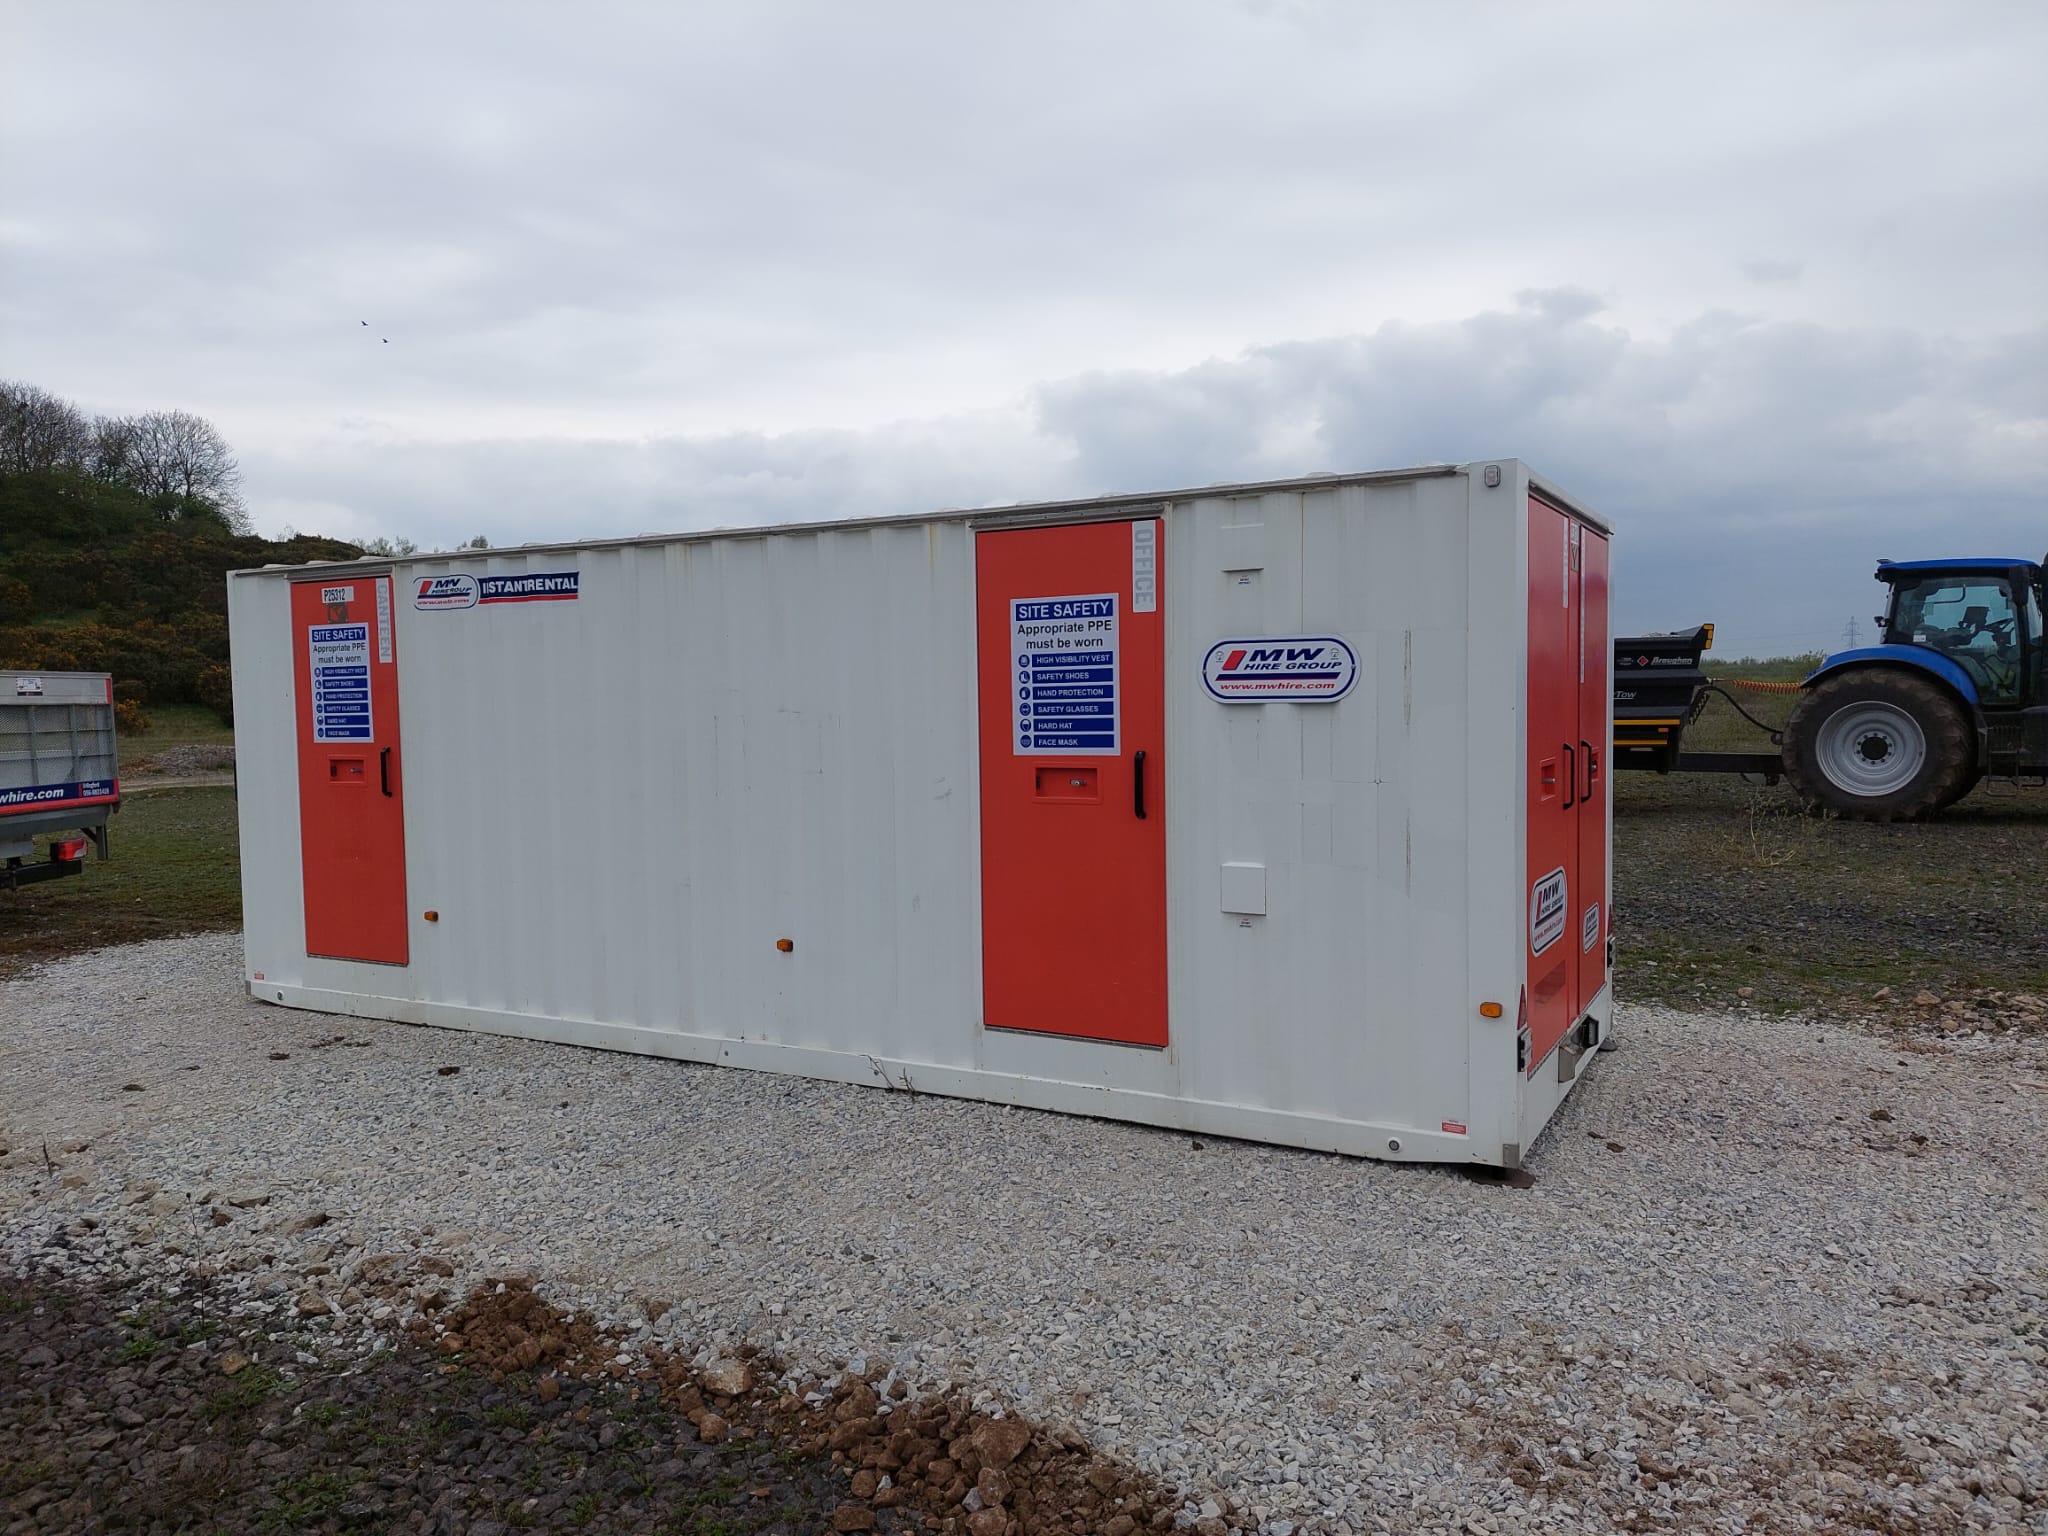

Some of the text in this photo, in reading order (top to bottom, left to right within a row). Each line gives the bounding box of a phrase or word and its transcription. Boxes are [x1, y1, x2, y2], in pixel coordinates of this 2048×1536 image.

[1135, 528, 1154, 604] OFFICE
[323, 588, 346, 602] P25312
[1018, 601, 1109, 619] SITE SAFETY
[378, 584, 391, 657] CANTEEN
[1017, 620, 1113, 637] Appropriate PPE
[313, 628, 364, 641] SITE SAFETY
[313, 642, 367, 653] Appropriate PPE
[1026, 637, 1103, 649] must be worn
[318, 655, 362, 664] must be worn
[1036, 654, 1110, 664] HIGH VISIBILITY VEST
[1249, 648, 1325, 662] MW
[1243, 661, 1343, 671] HIRE GROUP
[1220, 682, 1336, 690] www.mwhire.com
[1037, 688, 1104, 697] HAND PROTECTION
[1614, 690, 1637, 698] Tow
[1065, 705, 1099, 713] GLASSES
[1058, 738, 1079, 746] MASK
